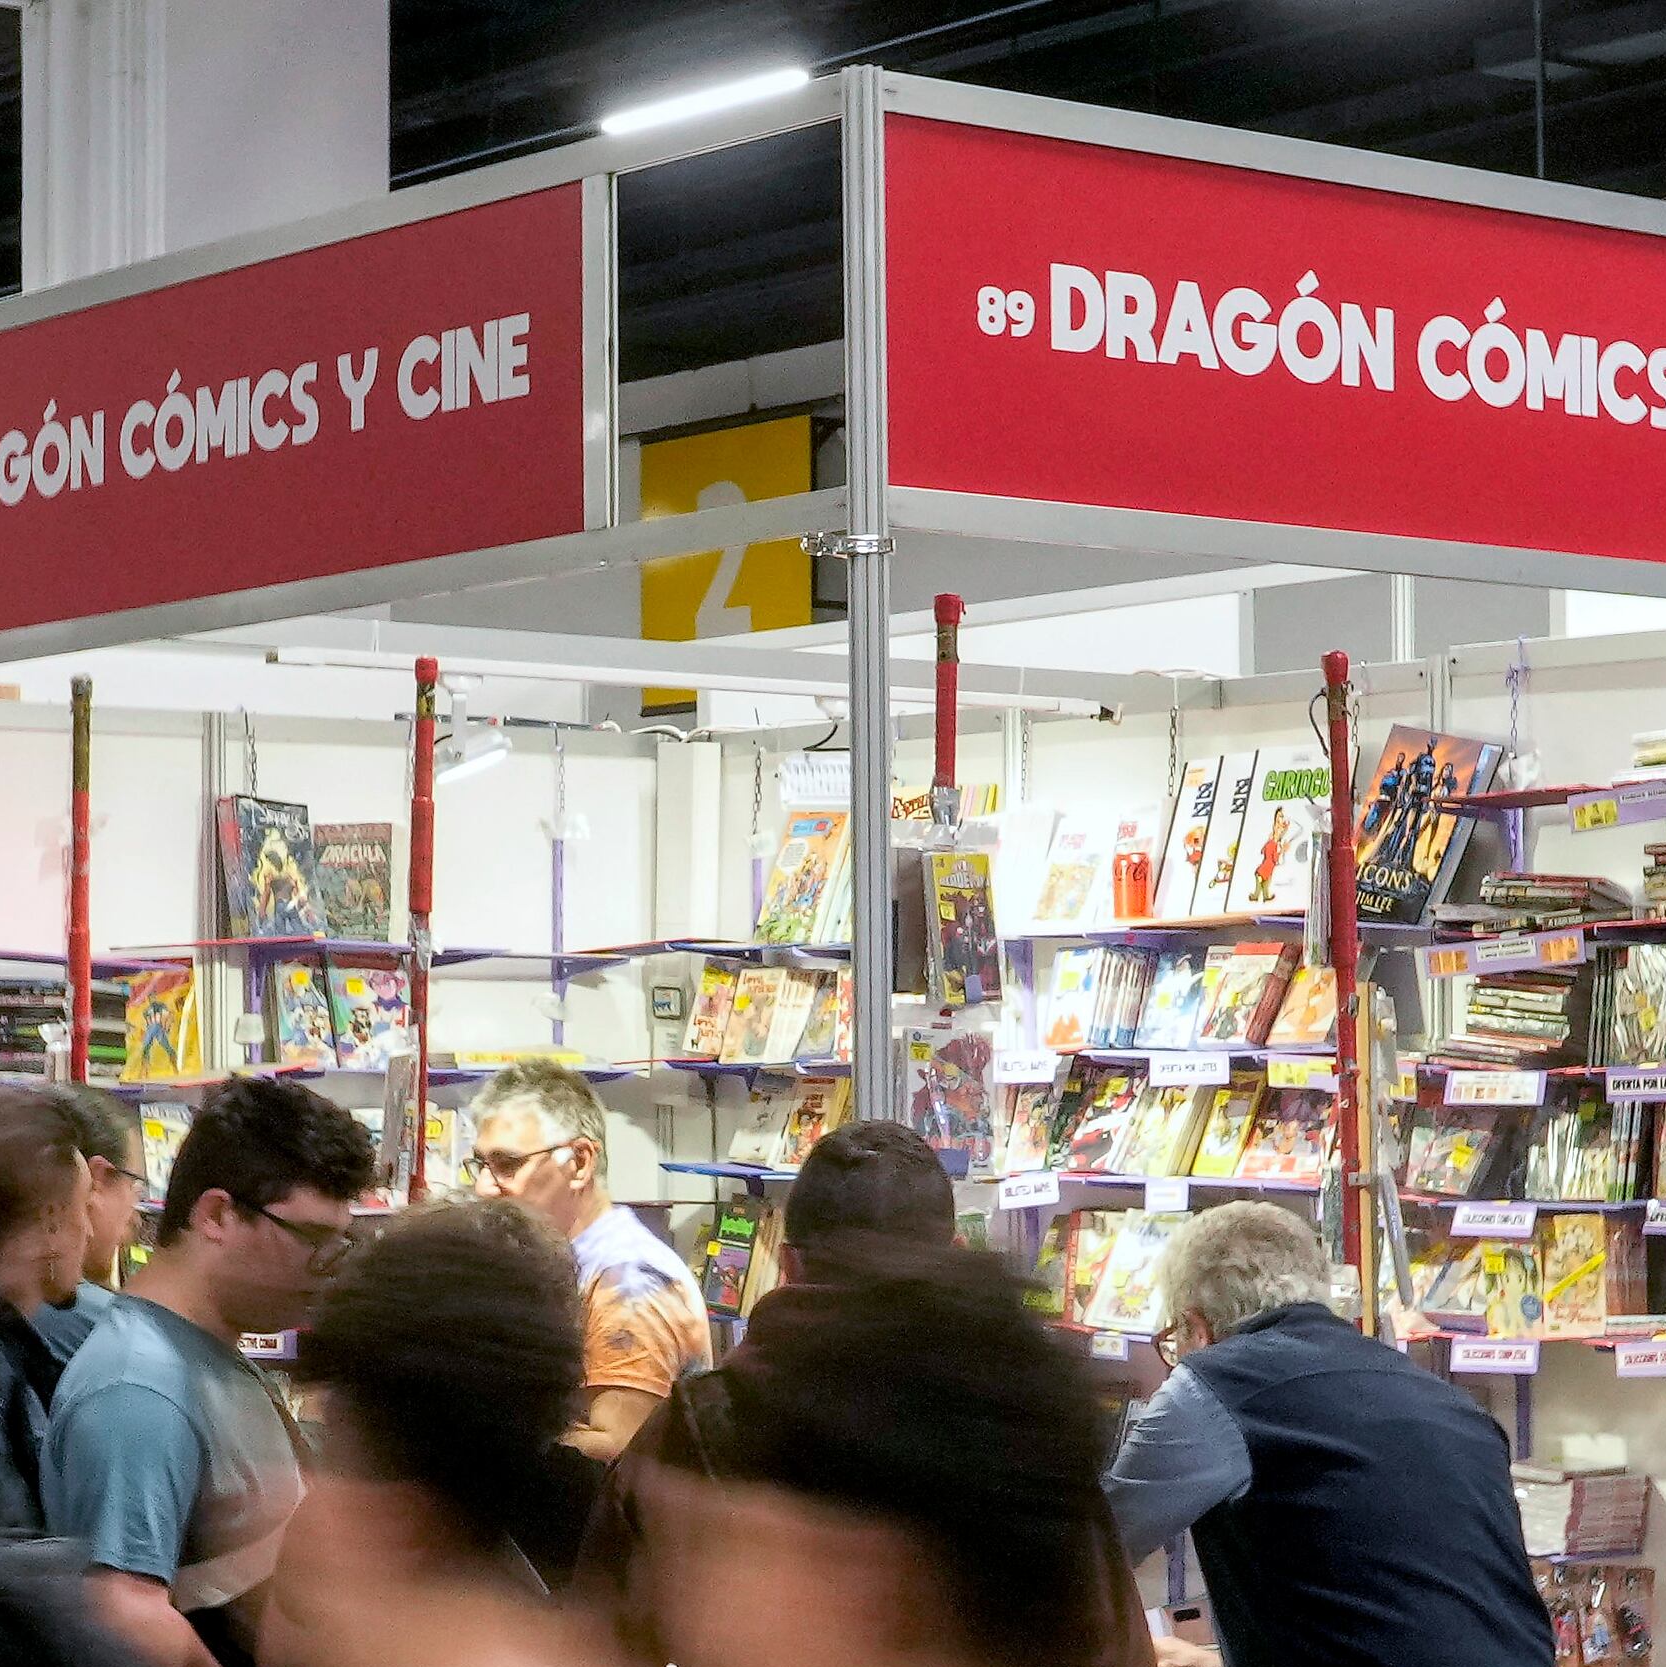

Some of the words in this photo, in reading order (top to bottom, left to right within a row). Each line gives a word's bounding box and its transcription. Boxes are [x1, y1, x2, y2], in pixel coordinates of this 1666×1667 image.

[977, 285, 1036, 340] 89
[1049, 262, 1395, 392] DRAGÓN
[119, 362, 320, 480] CÓMICS
[337, 347, 379, 432] Y
[397, 312, 530, 421] CINE
[1355, 862, 1414, 892] ICONS
